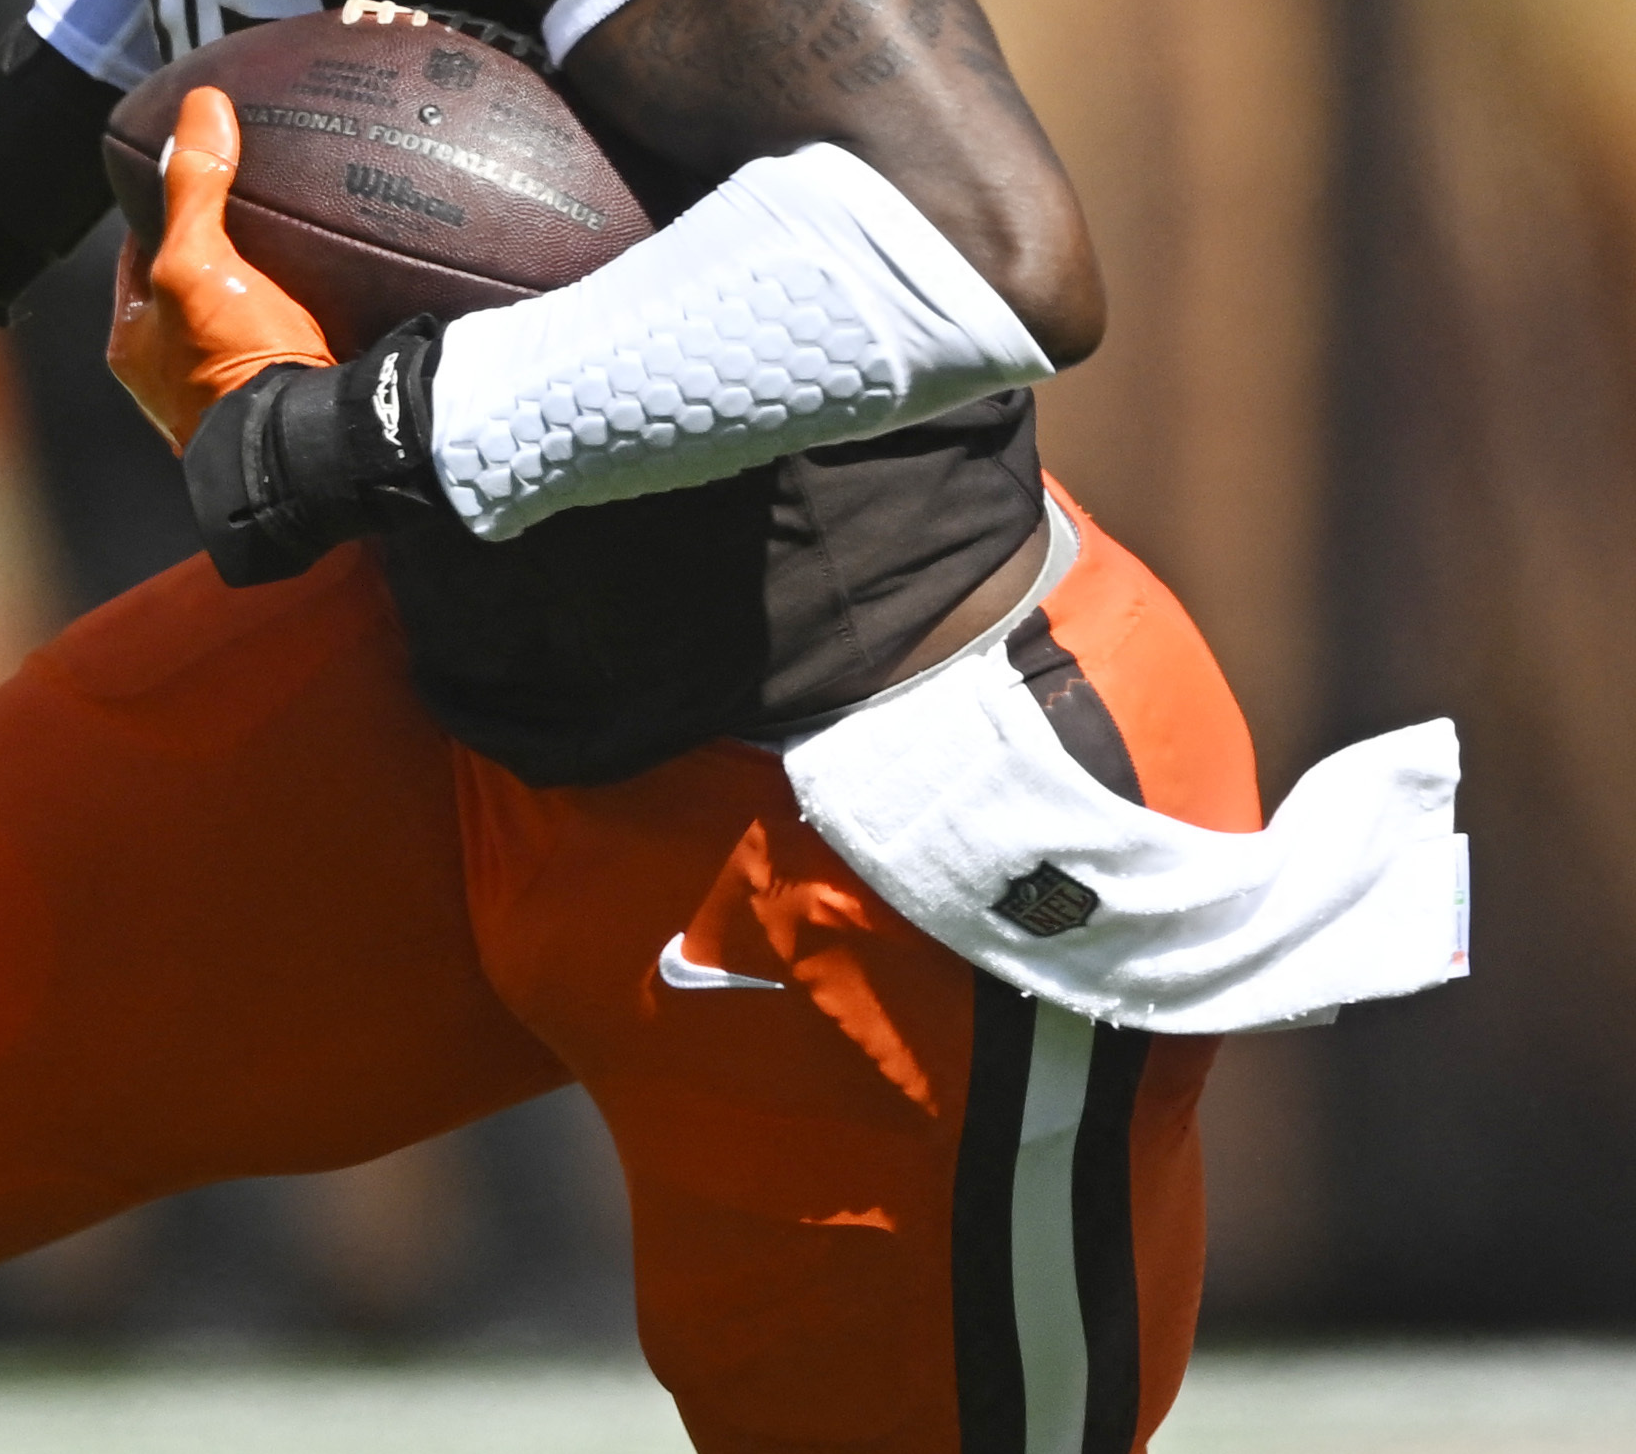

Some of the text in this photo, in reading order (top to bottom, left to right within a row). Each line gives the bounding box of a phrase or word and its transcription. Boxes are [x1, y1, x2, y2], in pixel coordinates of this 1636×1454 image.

[242, 103, 359, 137] NATIONAL
[368, 124, 504, 182] FOOTBALL
[507, 171, 606, 232] LEAGUE
